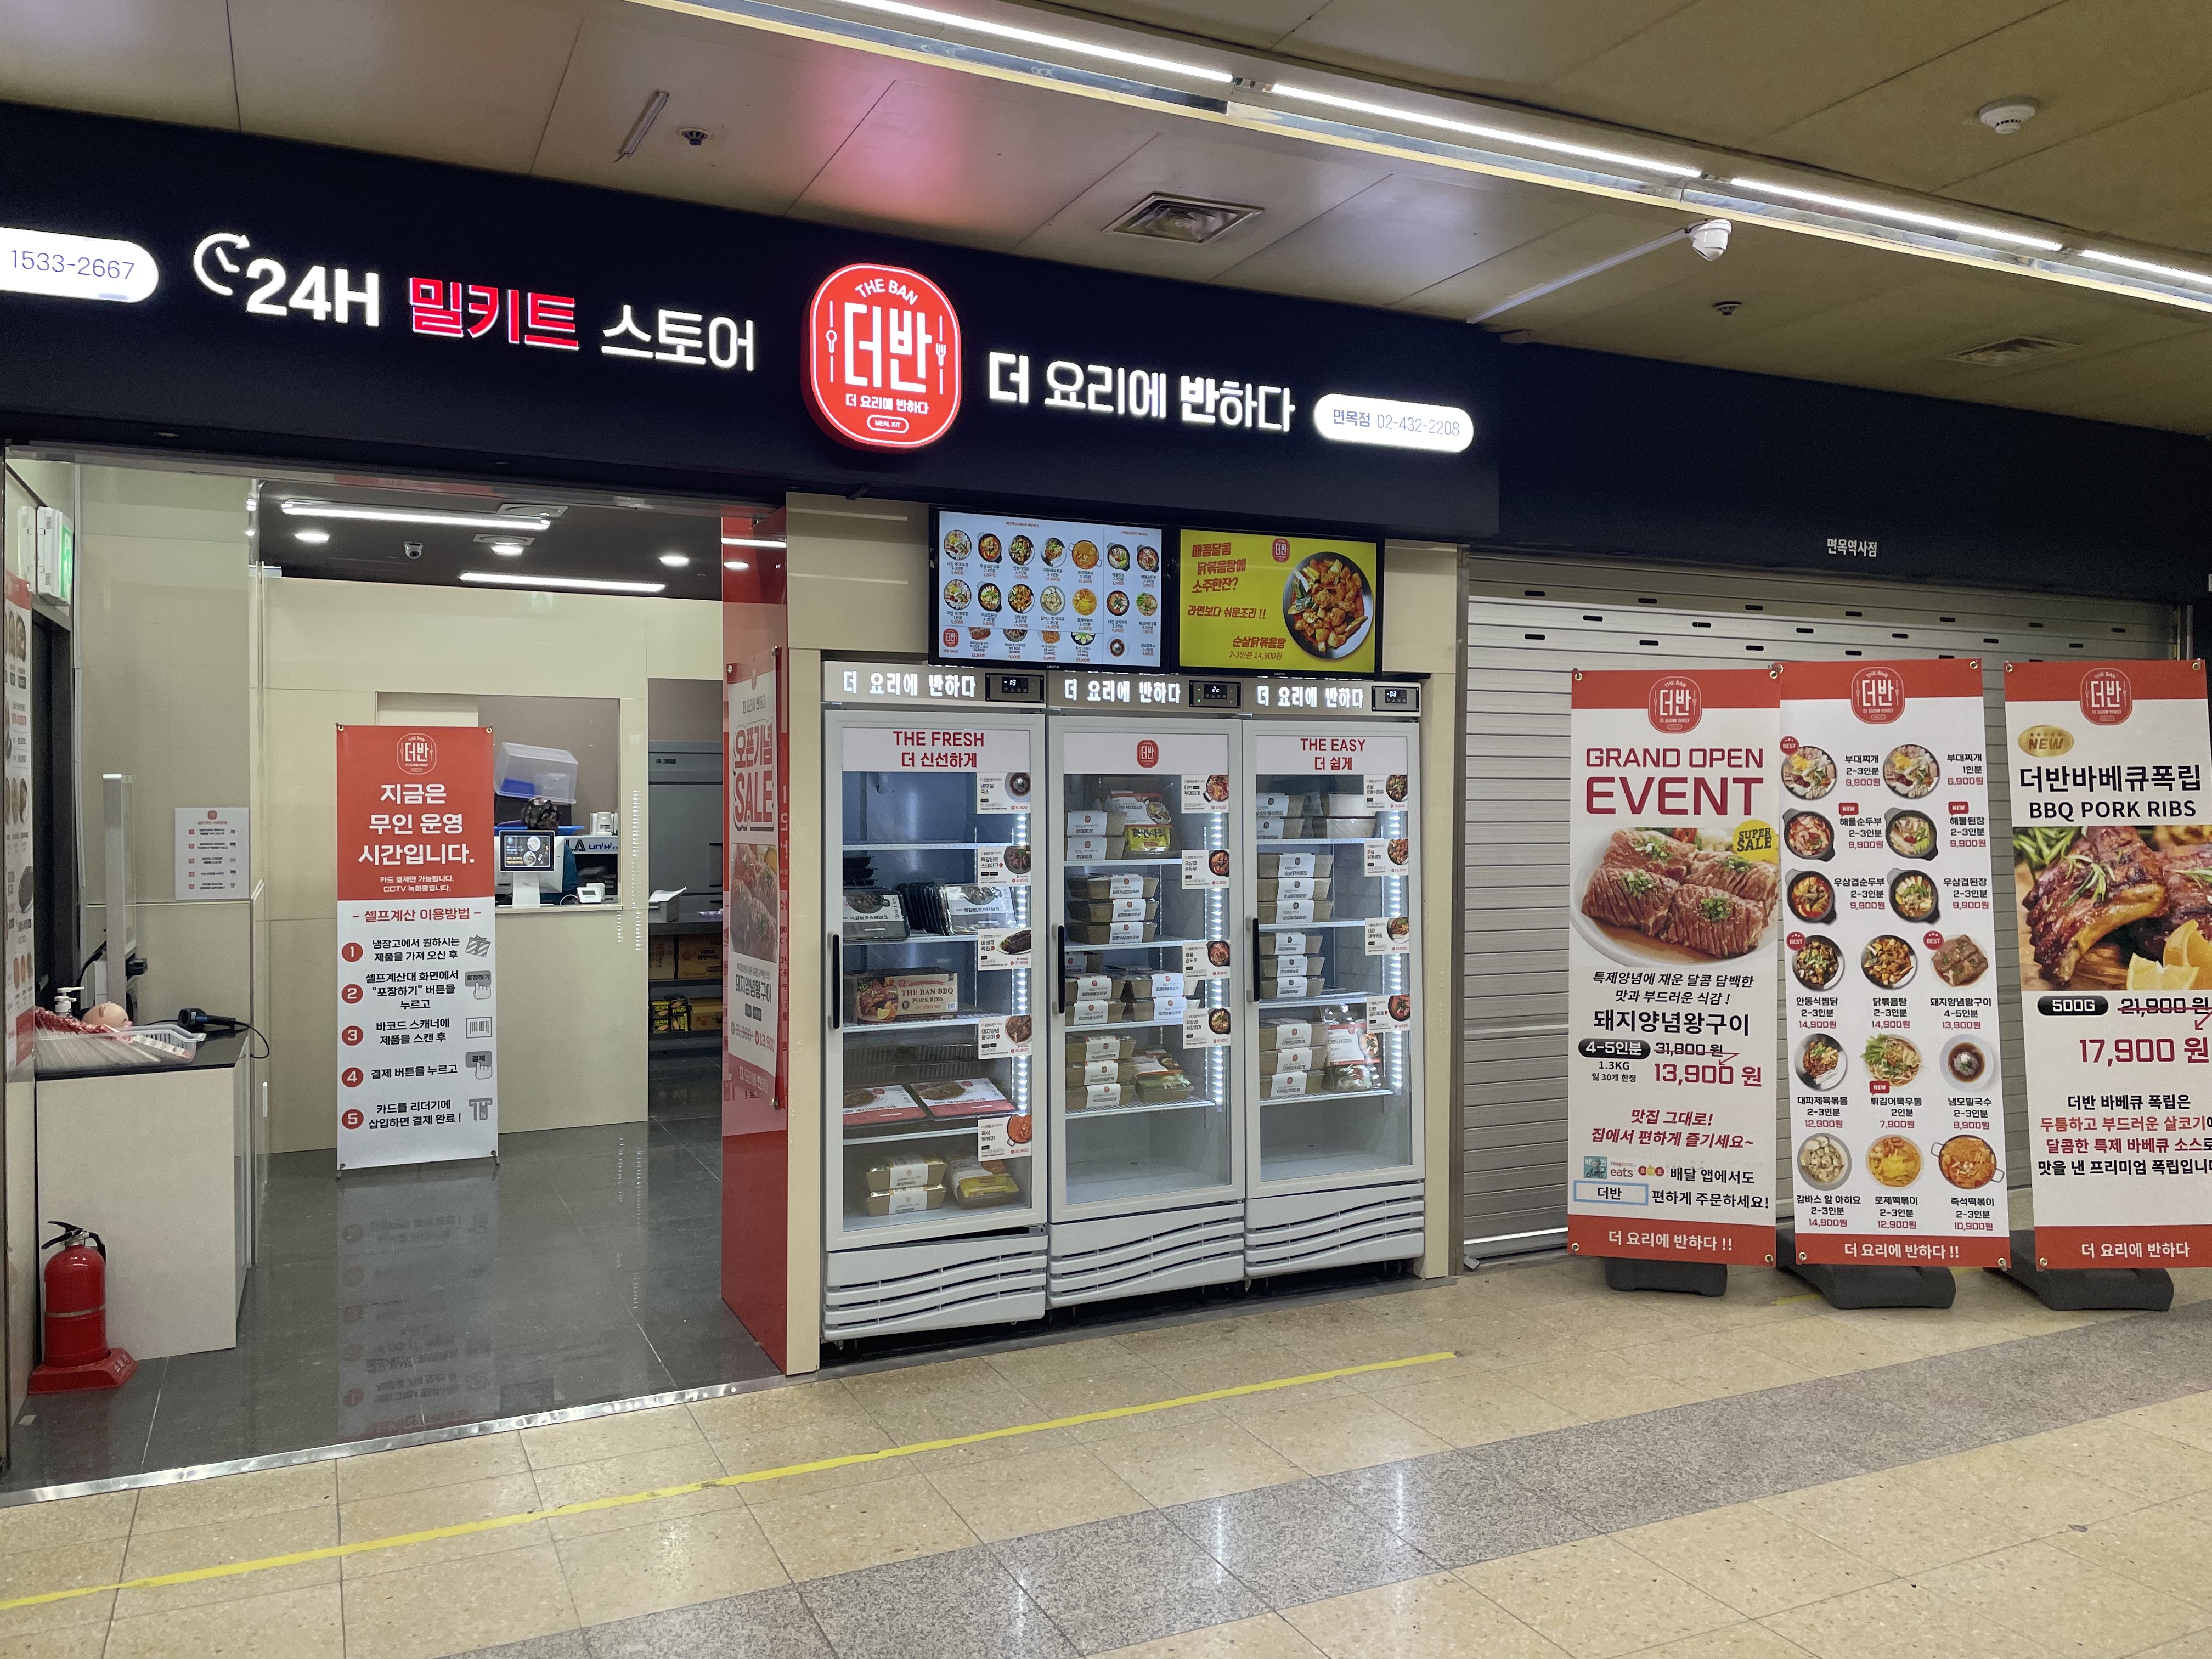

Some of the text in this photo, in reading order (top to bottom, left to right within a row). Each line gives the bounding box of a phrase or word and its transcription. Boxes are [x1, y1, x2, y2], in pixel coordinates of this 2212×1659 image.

[11, 249, 134, 280] 1533-2667
[855, 279, 918, 305] THE BAN
[246, 258, 754, 371] 24H 밀키트 스토어
[845, 302, 932, 393] 더반
[989, 352, 1295, 432] 더 요리에 반하다
[846, 394, 929, 414] 더 요리에 반하다
[1333, 409, 1460, 436] 면목점 02-432-2208
[1827, 538, 1877, 557] 면목역사점
[1192, 577, 1239, 593] 소주한잔?
[1188, 605, 1257, 618] 라면보다 쉬운조리
[1233, 636, 1287, 649] 순살닭볶음탕
[1254, 652, 1283, 660] 14,900원
[843, 671, 975, 698] 더 요리에 반하다
[1660, 689, 1691, 716] 더반
[735, 723, 772, 768] 오픈기념
[893, 731, 984, 747] THE FRESH
[1301, 738, 1365, 752] THE EASY
[2028, 738, 2064, 750] NEW
[405, 743, 428, 762] 더반
[901, 752, 977, 768] 더 신선하게
[1587, 748, 1763, 768] GRAND OPEN
[1845, 755, 1879, 763] 부대찌개
[1314, 757, 1352, 770] 더 쉽게
[1846, 778, 1881, 787] 9,900원
[2020, 764, 2200, 793] 더반바베큐폭립
[380, 783, 447, 804] 지금은
[735, 770, 773, 823] SALE
[1587, 777, 1764, 815] EVENT
[2029, 800, 2196, 822] BBQ PORK RIBS
[369, 814, 463, 834] 무인 운영
[1839, 817, 1882, 826] 해물순두부
[1950, 817, 1984, 825] 해물된장
[1739, 828, 1771, 839] SUPER
[1737, 836, 1772, 852] SALE
[358, 844, 475, 865] 시간입니다.
[1834, 878, 1885, 887] 우삼겹순두부
[1943, 878, 1987, 887] 우삼겹된장
[364, 907, 470, 923] 셀프계산 이용방법
[373, 938, 460, 949] 냉장고에서 원하시는
[374, 950, 458, 961] 제품을 가져 오신 후
[365, 970, 459, 983] 셀프계산대 화면에서
[1593, 971, 1754, 989] 특제양념에 재운 달콤 담백한
[372, 984, 455, 996] "포장하기" 버튼을
[1615, 990, 1723, 1006] 맛과 부드러운 식감
[400, 1000, 430, 1009] 누르고
[1796, 997, 1838, 1006] 안동식찜닭
[1873, 997, 1907, 1006] 닭볶음탕
[1930, 998, 1991, 1007] 돼지양념왕구이
[2052, 999, 2095, 1012] 500G
[376, 1018, 450, 1031] 바코드 스캐너에
[1594, 1009, 1748, 1036] 돼지양념왕구이
[1799, 1020, 1837, 1029] 14,900원
[1585, 1041, 1643, 1056] 4-5인분
[2080, 1037, 2209, 1067] 17,900 원
[371, 1064, 458, 1079] 결제 버튼을 누르고
[1599, 1061, 1630, 1070] 1.3KG
[1601, 1074, 1637, 1082] 30개 한정
[1655, 1063, 1762, 1087] 13,900 원
[376, 1100, 450, 1114] 카드를 리더기에
[1948, 1097, 1992, 1106] 냉모밀국수
[2068, 1094, 2191, 1110] 더반 바베큐 폭립은
[369, 1114, 455, 1129] 삽입하면 결제 완료
[1631, 1109, 1713, 1126] 맛집 그대로!
[2040, 1116, 2159, 1132] 두툼하고 부드러운
[1592, 1128, 1754, 1149] 집에서 편하게 즐기세요~
[2046, 1138, 2089, 1154] 달콤한
[2094, 1138, 2122, 1153] 특제
[2127, 1138, 2169, 1153] 바베큐
[1610, 1168, 1633, 1177] eats
[1671, 1168, 1754, 1184] 배달 앱에서도
[2038, 1160, 2147, 1176] 맛을 낸 프리미엄
[1598, 1187, 1622, 1200] 더반
[1652, 1190, 1768, 1209] 편하게 주문하세요!
[1797, 1195, 1861, 1205] 감바스 알 아히요
[1875, 1196, 1918, 1205] 로제떡볶이
[1950, 1198, 1994, 1207] 즉석떡볶이
[1954, 1222, 1993, 1231] 10,900원
